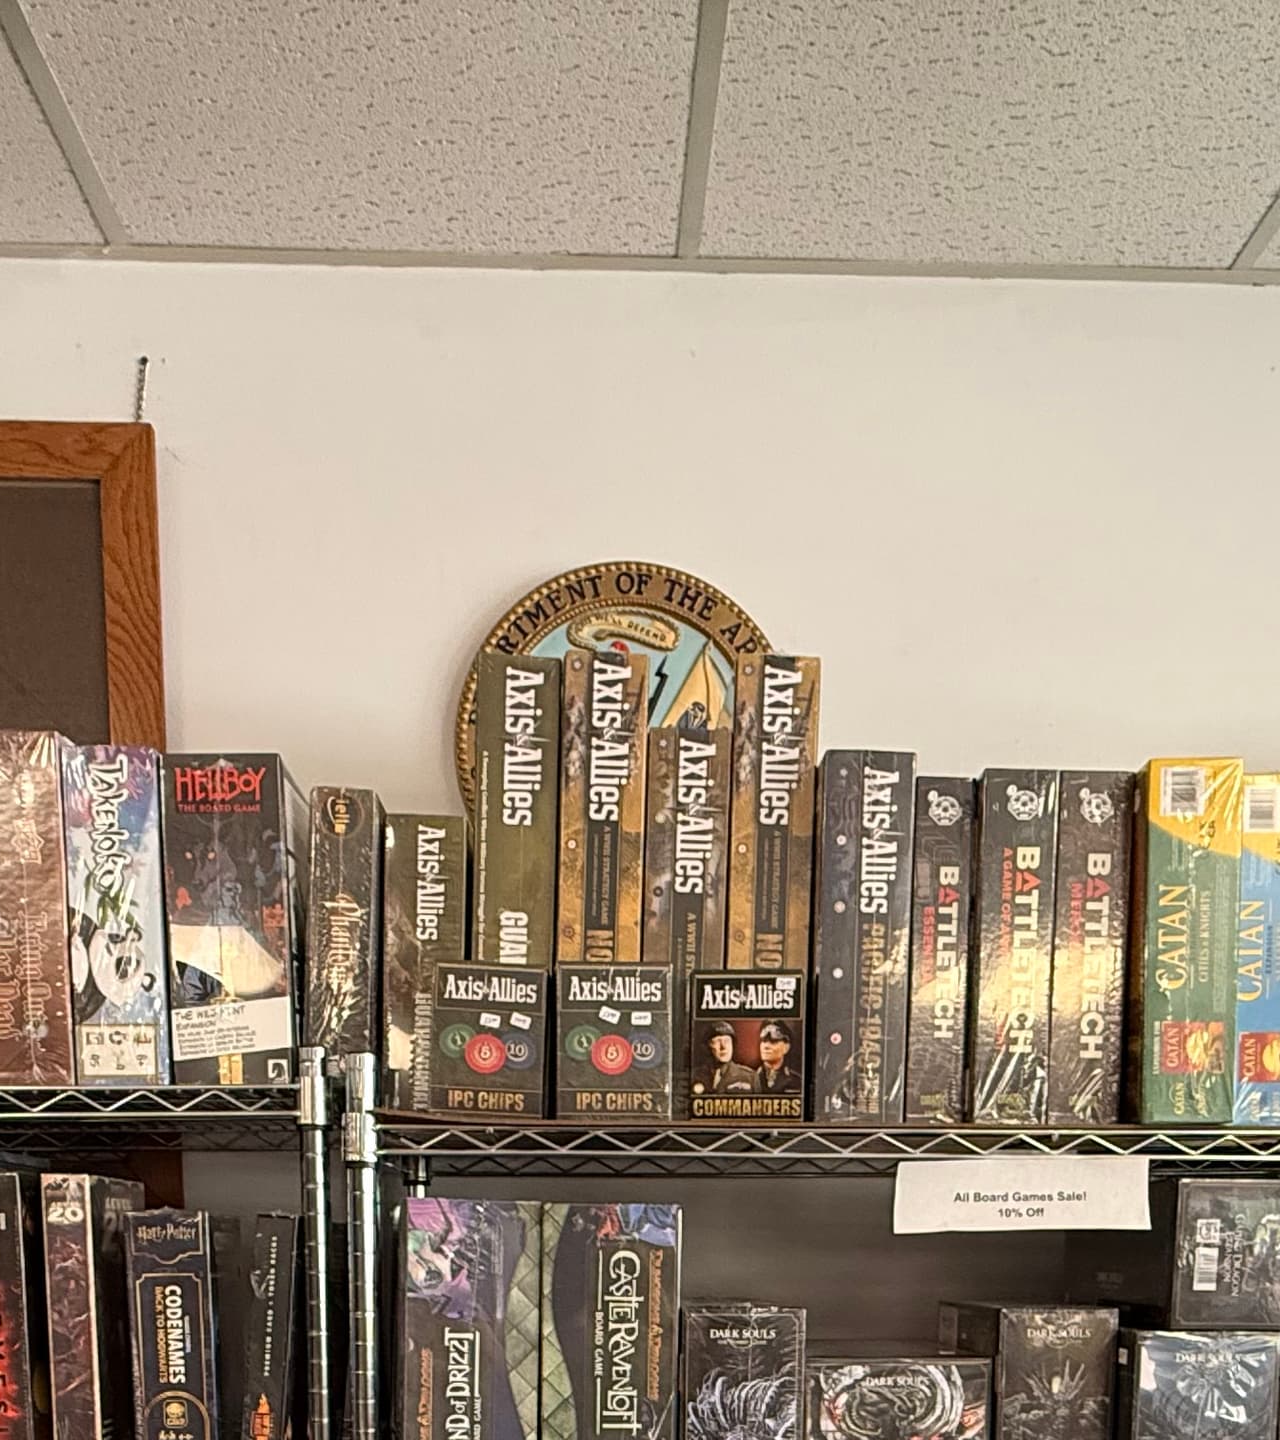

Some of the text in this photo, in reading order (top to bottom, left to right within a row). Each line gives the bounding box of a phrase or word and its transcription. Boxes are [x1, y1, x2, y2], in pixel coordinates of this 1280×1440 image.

[615, 572, 719, 621] OF THE
[175, 766, 266, 800] HELLBOY
[179, 804, 260, 812] THE BOARD GAME
[933, 866, 960, 1040] BATTLETECH
[1008, 846, 1041, 1054] BATTLETECH
[1156, 885, 1189, 995] CATAN
[1237, 899, 1265, 1002] CATAN
[1081, 853, 1111, 1060] BATTLETECH
[448, 1090, 523, 1111] IPC CHIPS
[576, 1092, 652, 1111] IPC CHIPS
[694, 1098, 801, 1116] COMMANDERS
[954, 1192, 1087, 1202] All Board Games Sale!
[48, 1207, 83, 1223] 20
[999, 1208, 1044, 1218] 10% Off
[137, 1224, 197, 1242] Harry Potter
[165, 1285, 186, 1385] CODENAMES
[592, 1312, 604, 1377] BOARD GAME
[710, 1330, 776, 1340] DARK SOULS
